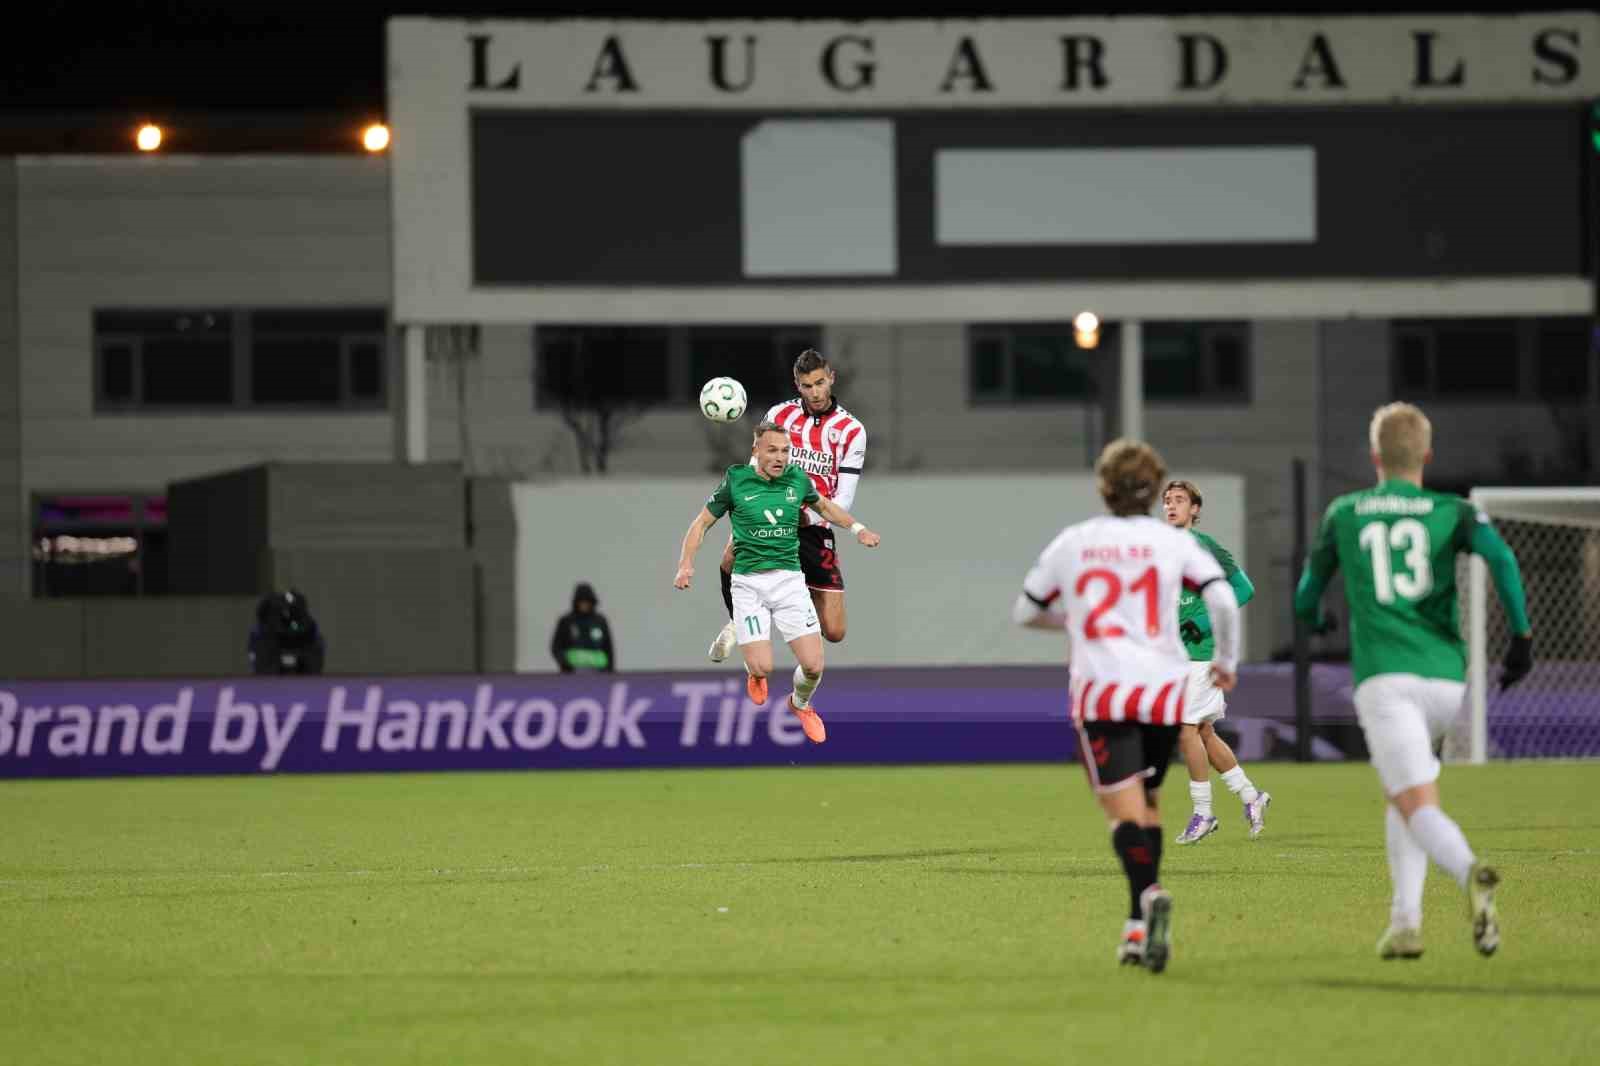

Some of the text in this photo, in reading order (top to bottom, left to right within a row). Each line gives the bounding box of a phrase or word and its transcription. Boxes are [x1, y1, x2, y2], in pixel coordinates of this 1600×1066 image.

[466, 27, 1582, 96] LAUGARDALS
[1359, 518, 1434, 605] 13
[744, 615, 762, 635] 11
[1074, 565, 1161, 640] 21
[209, 686, 306, 771] by
[321, 684, 652, 752] Hankook
[672, 679, 806, 747] Tire
